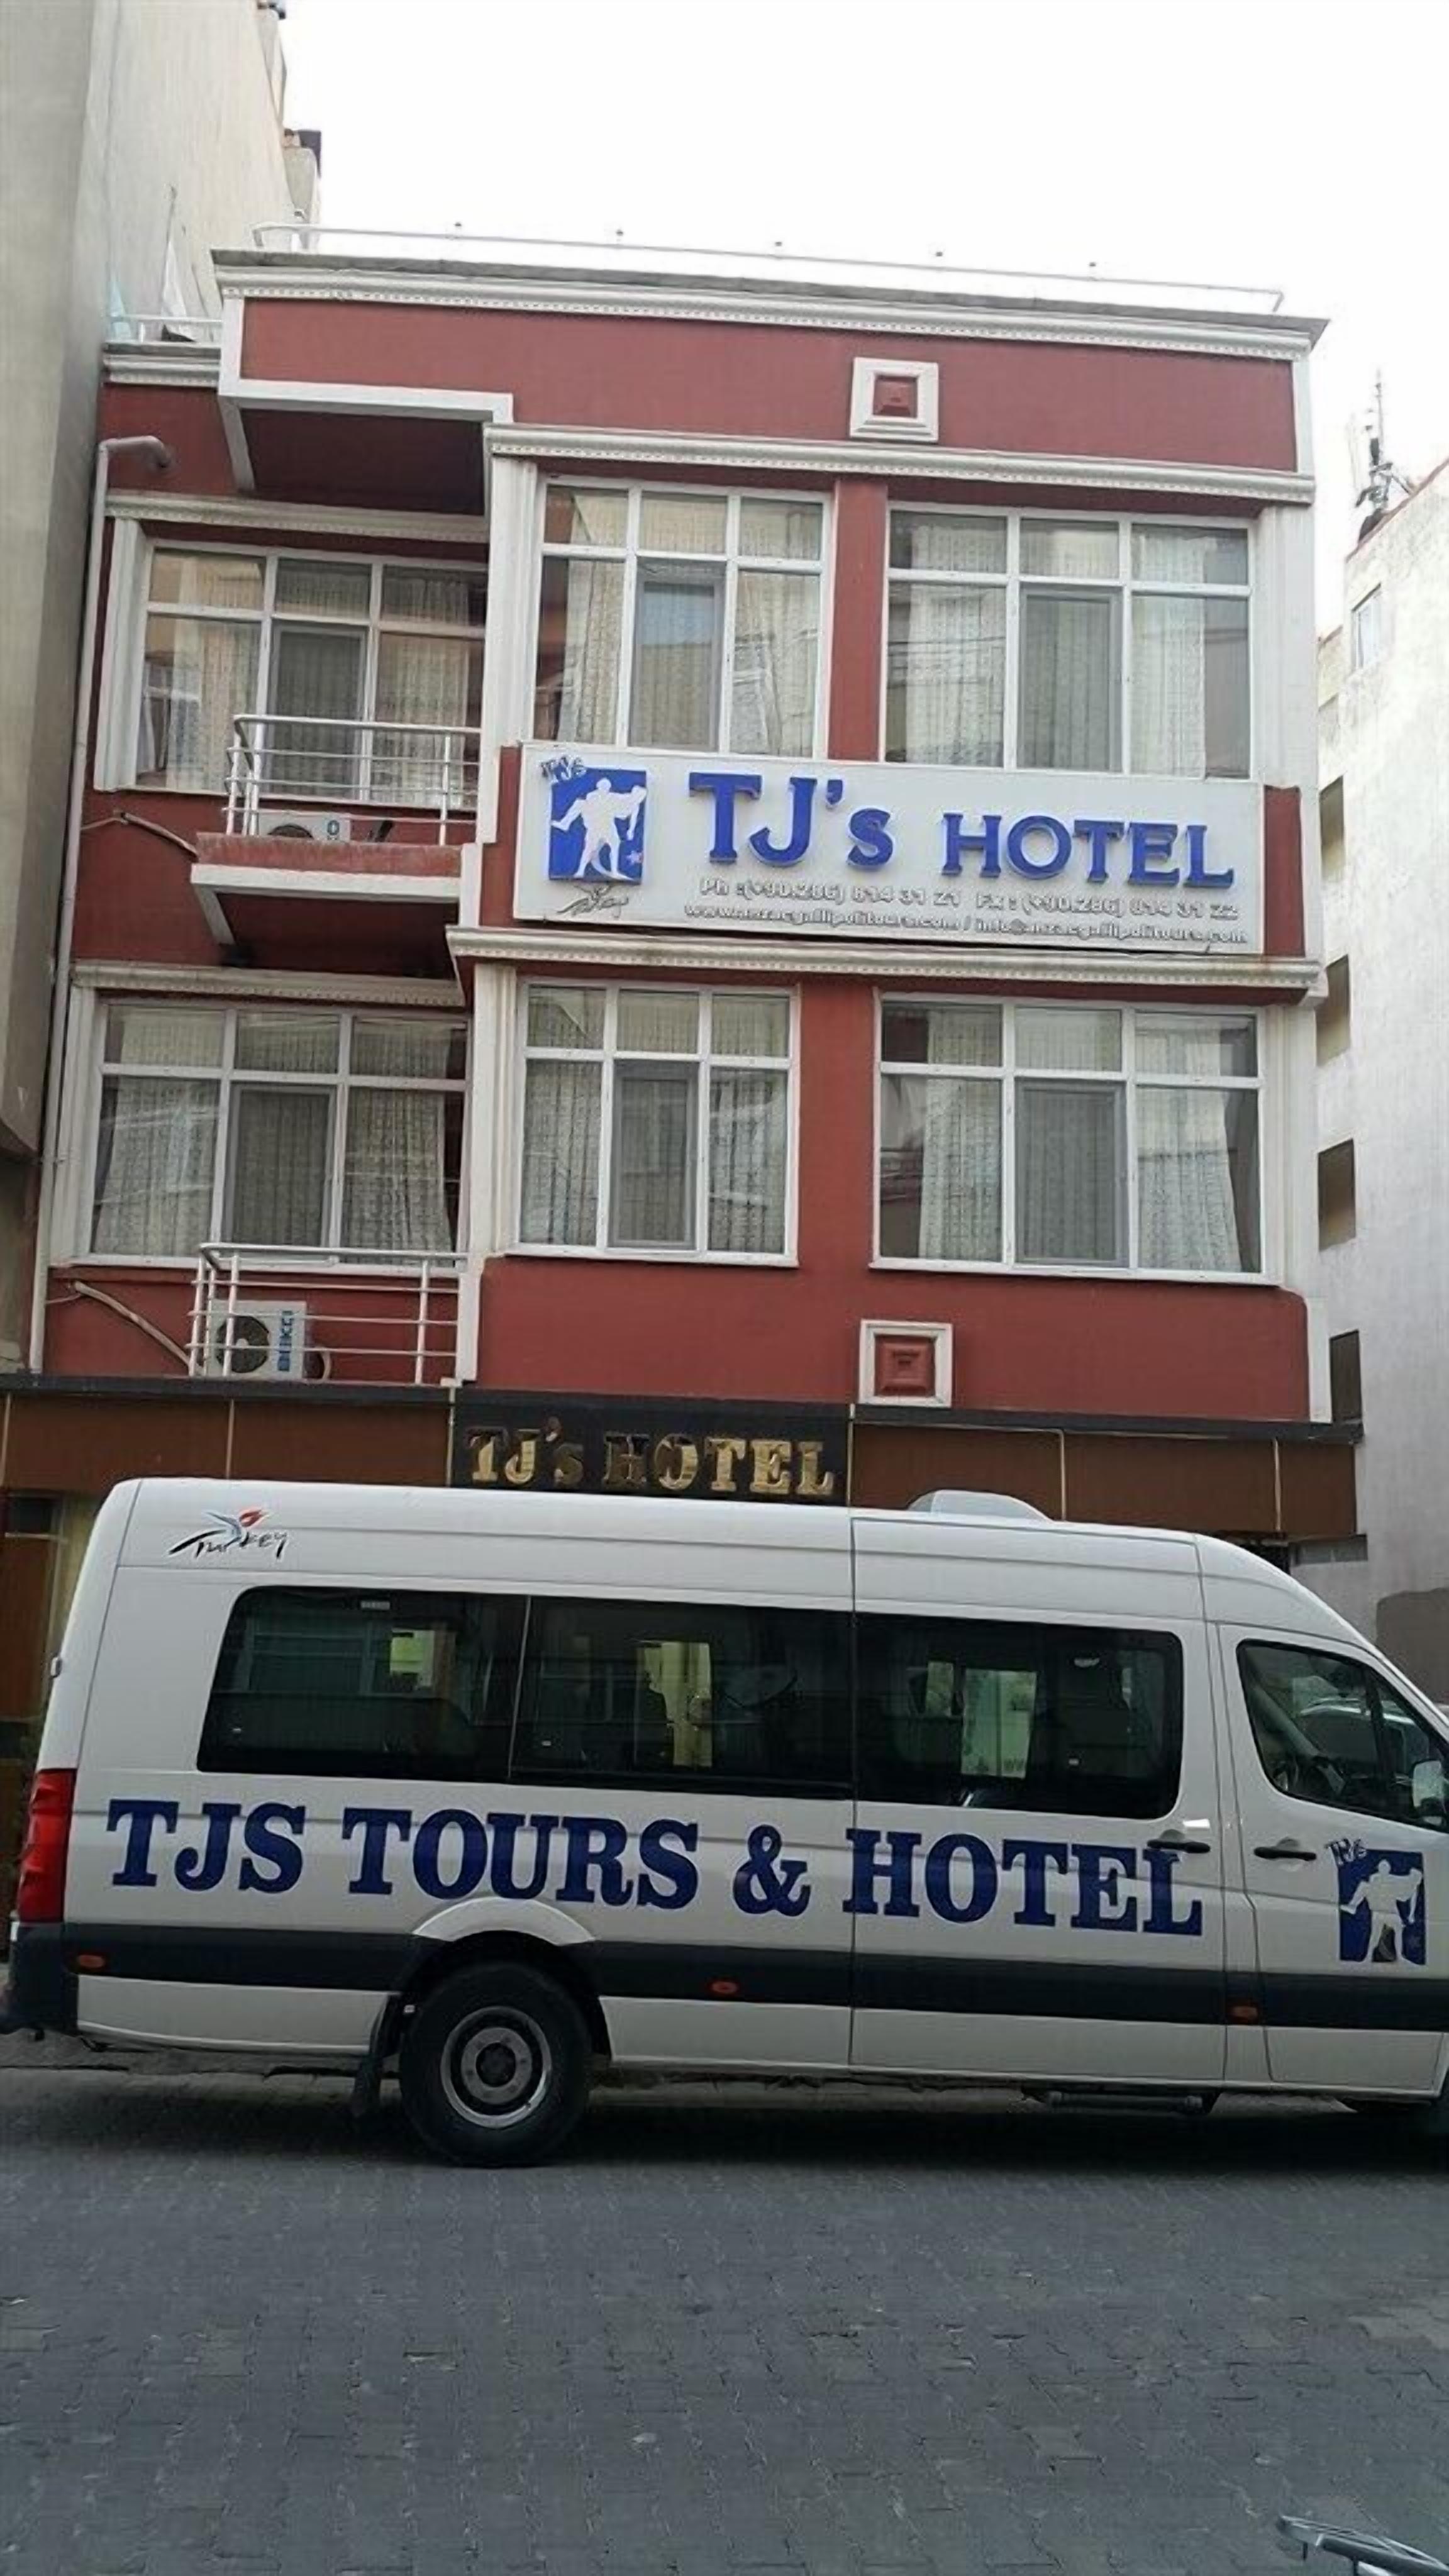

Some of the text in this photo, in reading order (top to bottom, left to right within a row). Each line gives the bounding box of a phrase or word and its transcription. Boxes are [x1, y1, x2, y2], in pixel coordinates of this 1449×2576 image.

[689, 772, 1235, 889] TJ's HOTEL
[700, 877, 730, 896] Ph
[602, 1430, 834, 1495] HOTEL
[106, 1799, 1203, 1936] TJS TOURS & HOTEL
